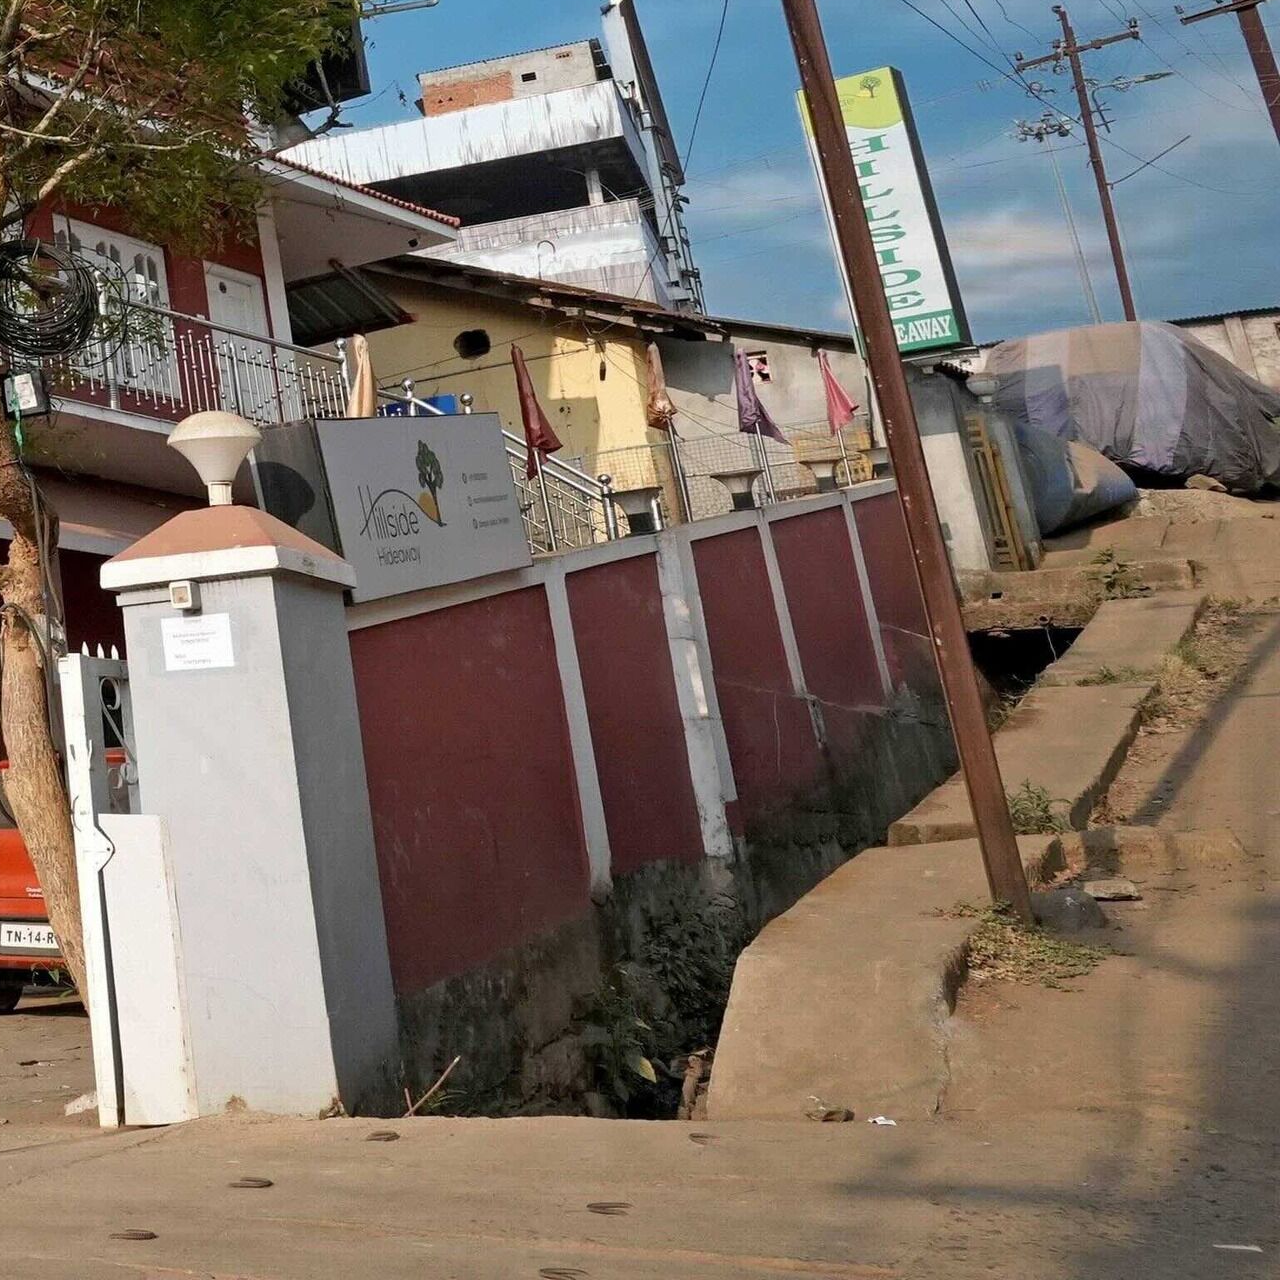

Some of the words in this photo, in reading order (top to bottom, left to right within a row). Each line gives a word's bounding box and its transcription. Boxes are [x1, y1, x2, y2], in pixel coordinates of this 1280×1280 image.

[894, 315, 952, 343] EAWAY
[357, 485, 420, 541] Hillside
[377, 546, 422, 567] Hideaway
